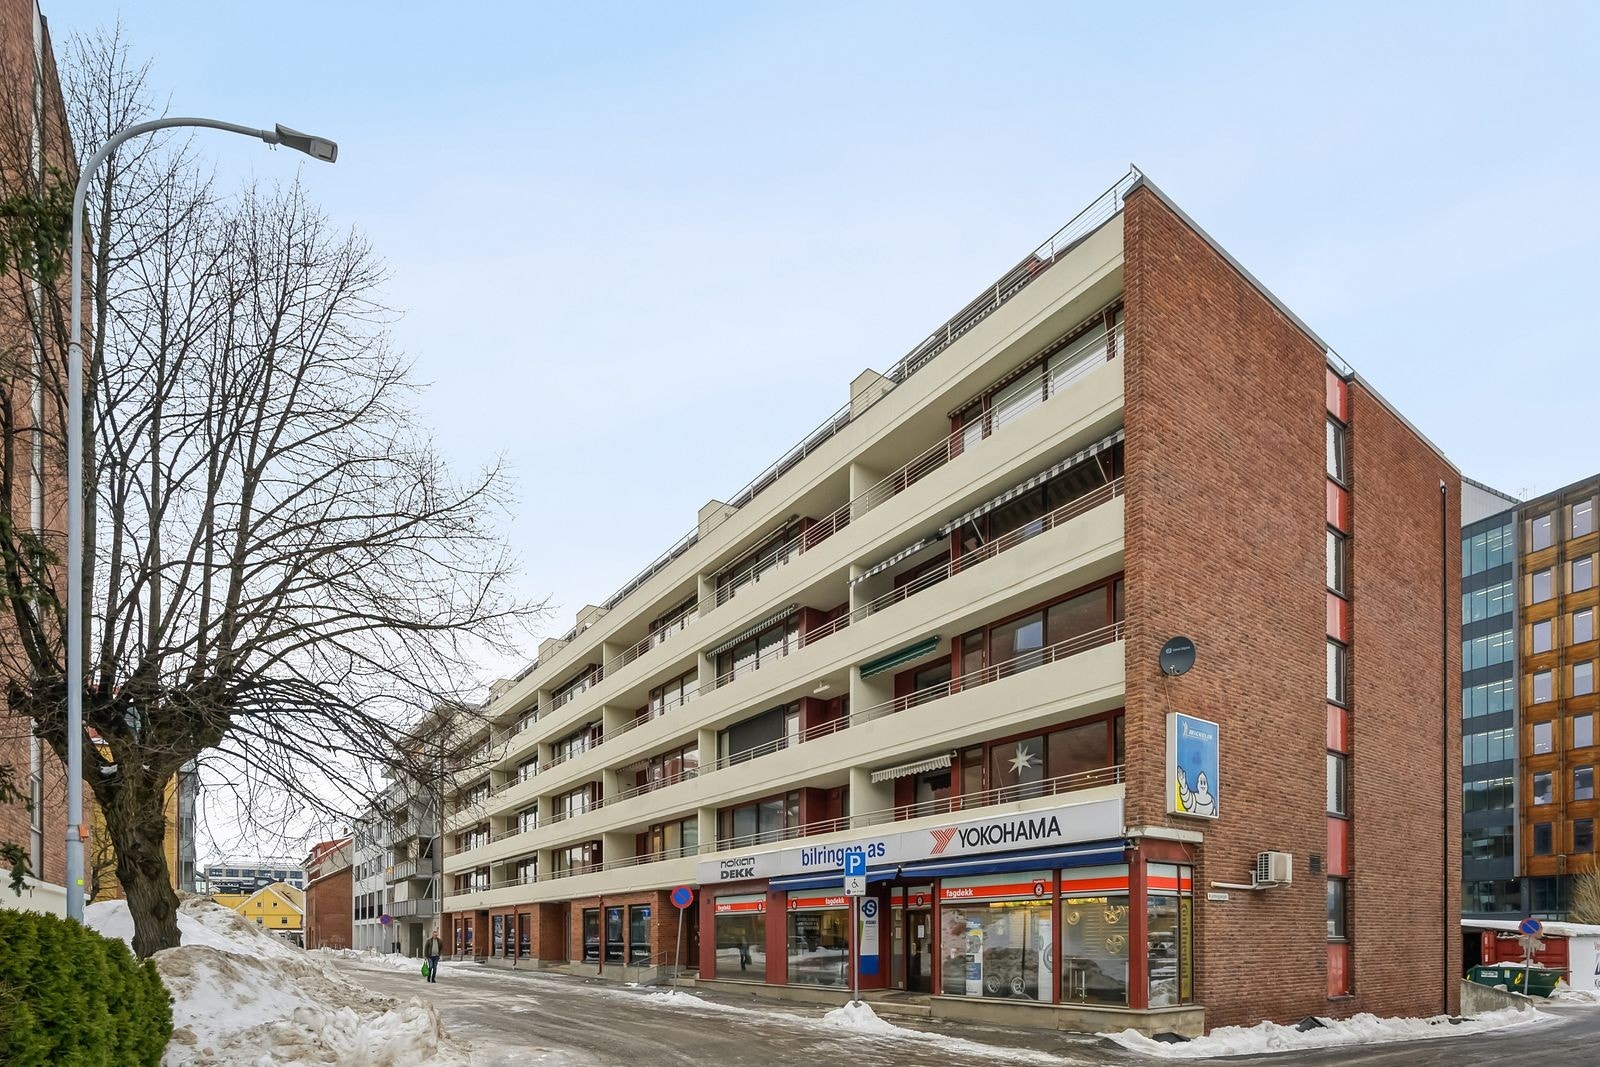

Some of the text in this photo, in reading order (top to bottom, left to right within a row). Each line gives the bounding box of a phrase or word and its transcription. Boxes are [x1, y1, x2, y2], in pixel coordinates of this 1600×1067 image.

[958, 816, 1061, 848] YOKOHAMA
[867, 842, 885, 858] as
[850, 856, 860, 874] P
[720, 867, 755, 879] DEKK
[946, 888, 973, 898] fagdekk
[825, 897, 844, 905] fagdekk
